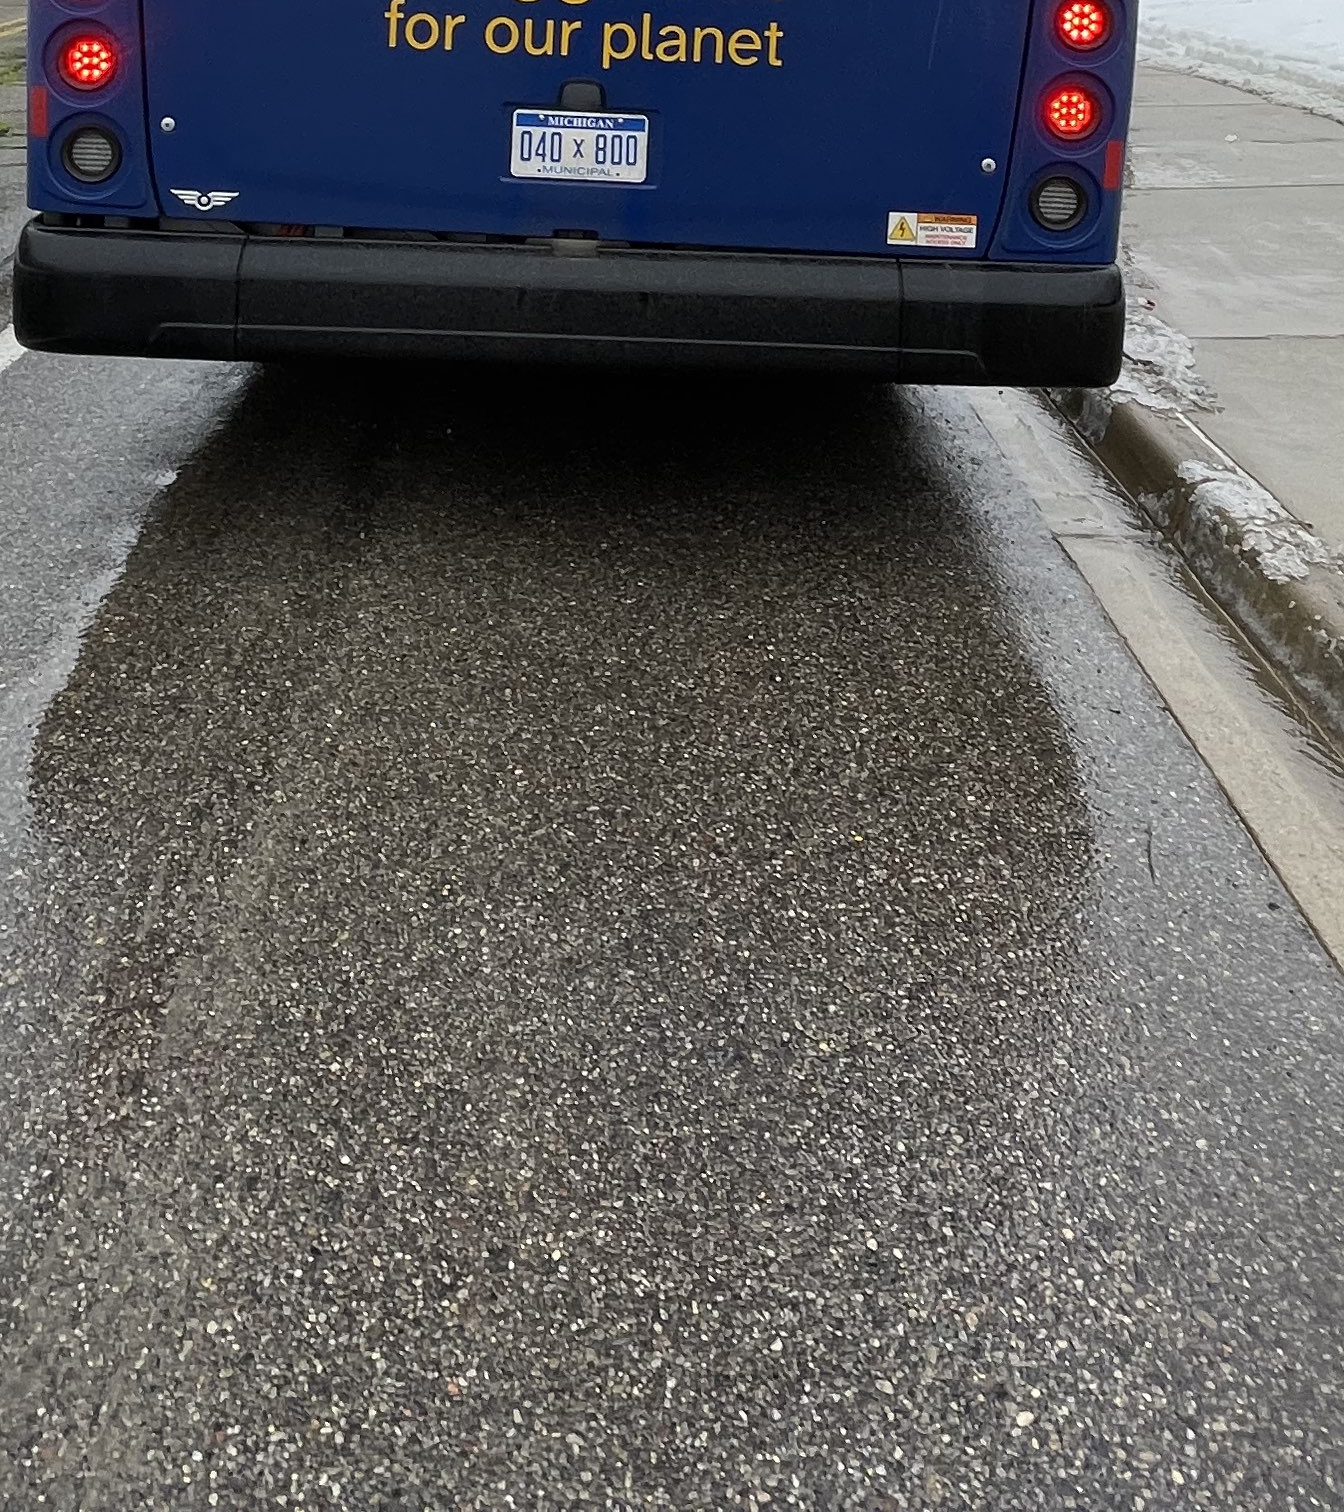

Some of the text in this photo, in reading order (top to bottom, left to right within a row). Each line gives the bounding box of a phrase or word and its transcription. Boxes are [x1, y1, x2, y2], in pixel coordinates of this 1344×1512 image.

[484, 15, 582, 57] our
[601, 12, 784, 69] planet
[547, 116, 615, 129] MICHIGAN
[520, 130, 562, 162] 040
[595, 133, 638, 166] 800
[542, 165, 613, 177] MUNICIPAL
[940, 226, 974, 234] VOLTAGE
